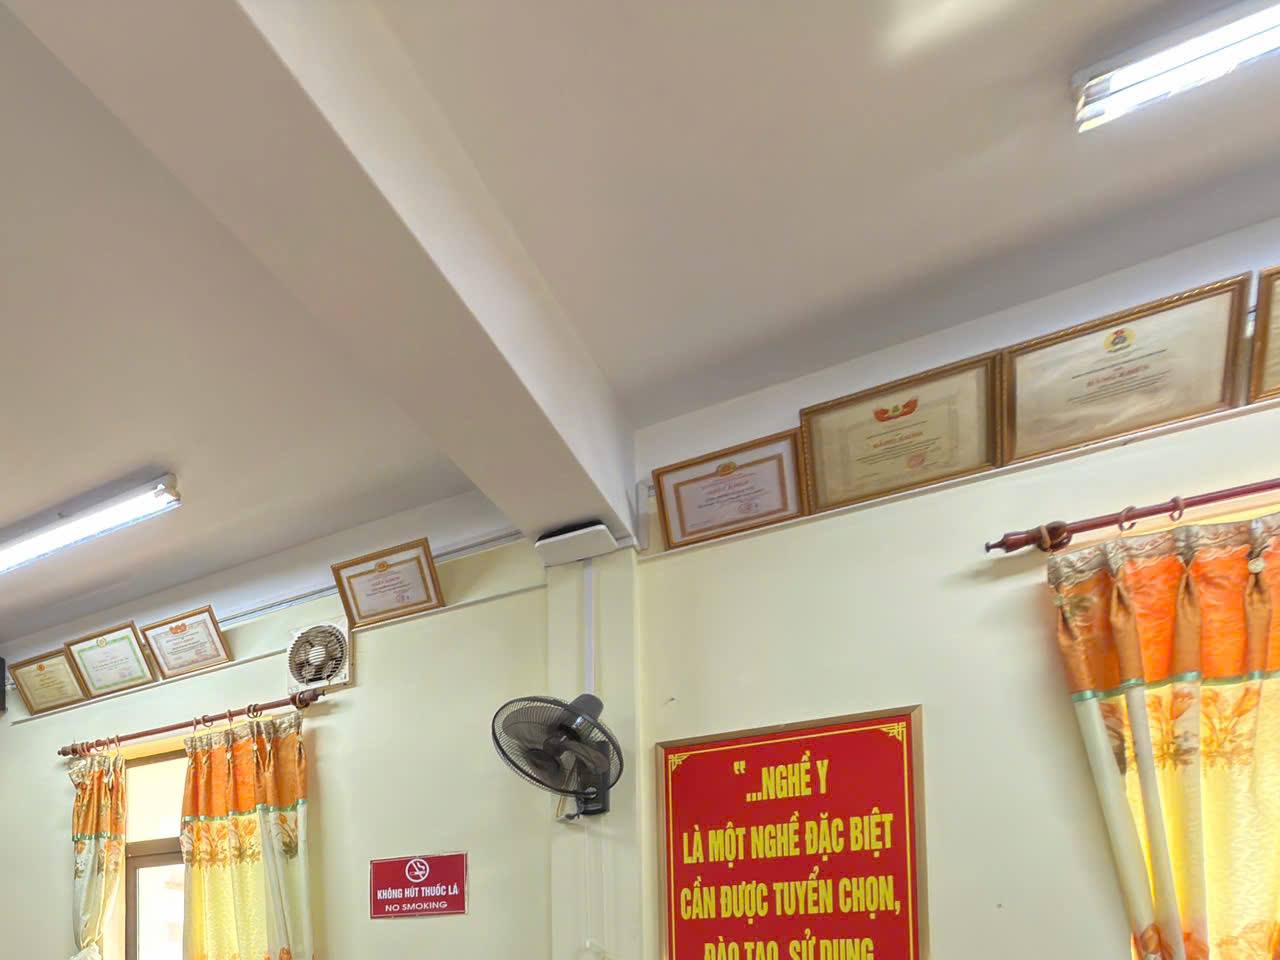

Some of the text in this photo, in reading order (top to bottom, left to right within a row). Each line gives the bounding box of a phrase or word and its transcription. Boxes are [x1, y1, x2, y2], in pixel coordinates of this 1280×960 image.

[816, 759, 829, 794] Y
[683, 807, 894, 868] LÀ MỘT NGHỀ ĐẶC BIỆT
[377, 882, 459, 900] KHÔNG HÚT THUỐC LÁ
[385, 900, 448, 912] NO SMOKING
[680, 865, 901, 925] CẦN ĐƯỢC TUYỂN CHỌN,
